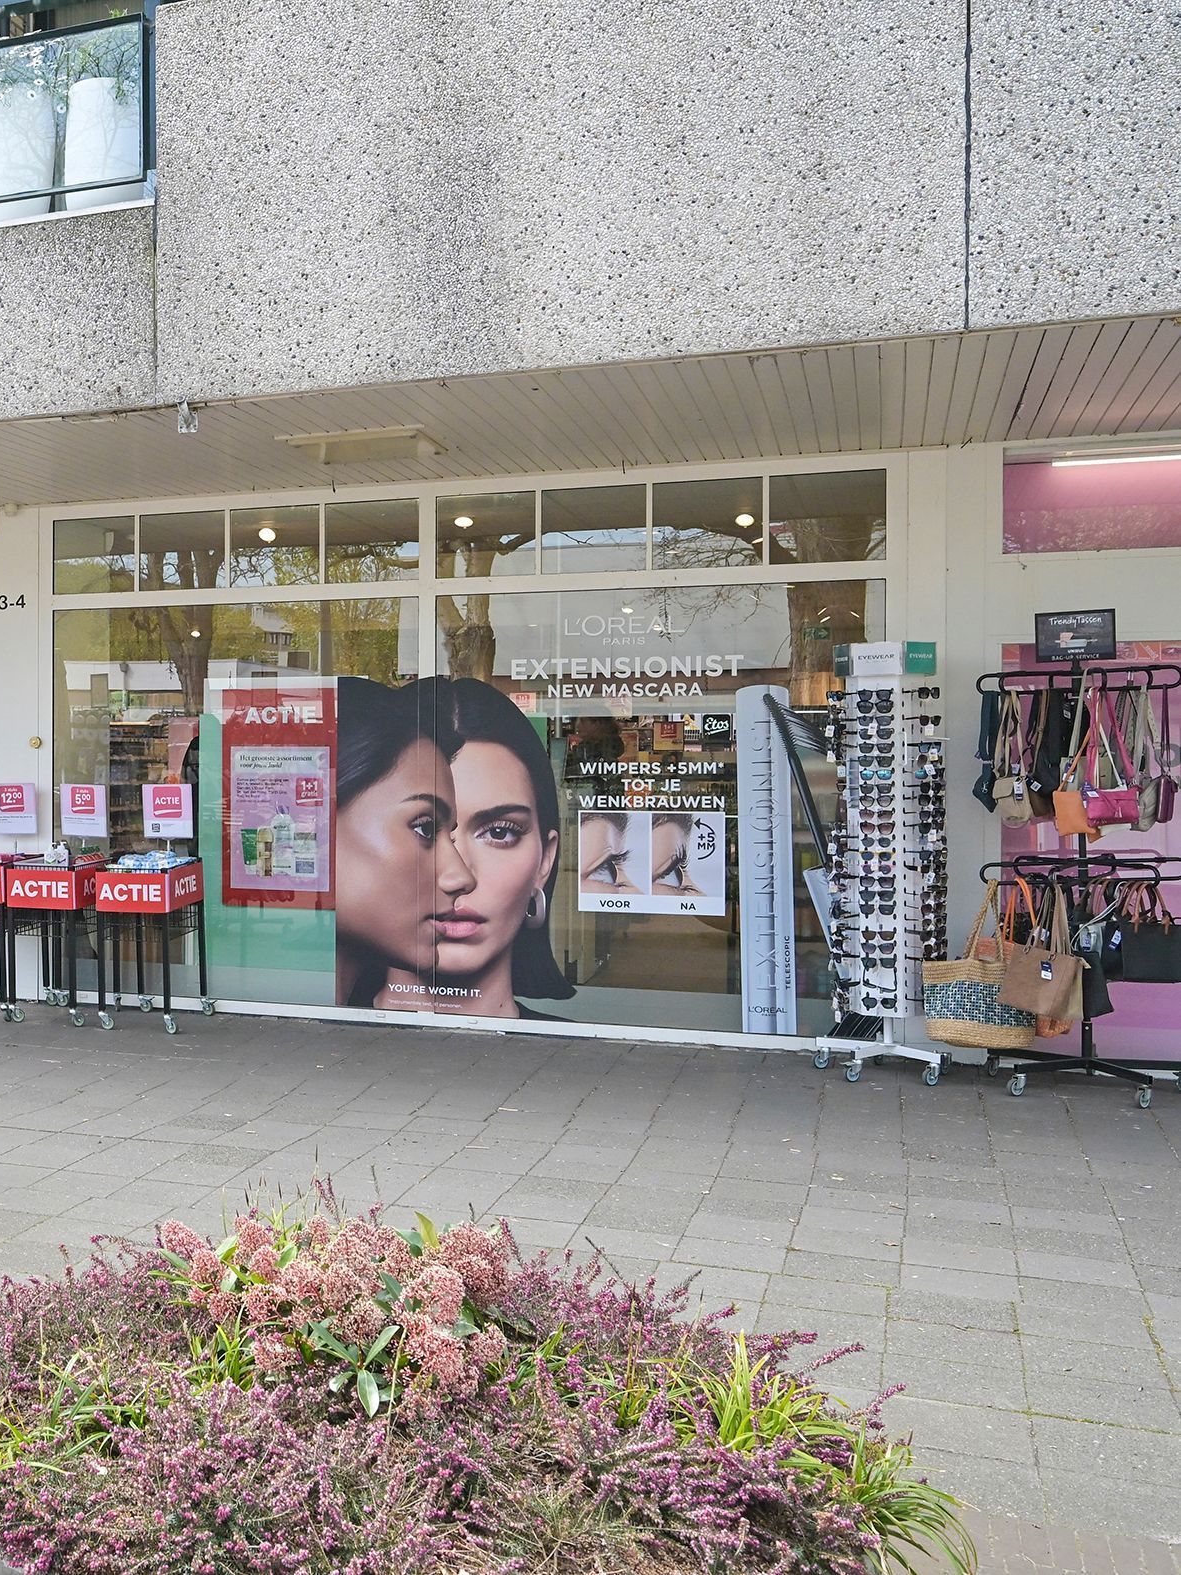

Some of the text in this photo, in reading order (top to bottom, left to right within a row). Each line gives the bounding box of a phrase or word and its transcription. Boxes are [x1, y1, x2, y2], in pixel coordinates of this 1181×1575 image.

[602, 637, 646, 646] PARIS
[510, 654, 745, 680] EXTENSIONIST
[547, 682, 703, 698] NEW MASCARA
[244, 706, 319, 724] ACTIE
[704, 717, 730, 731] Etos
[580, 762, 661, 775] WIMPERS
[300, 780, 318, 790] 1+1
[621, 778, 682, 792] TOT JE
[0, 792, 22, 804] 12.00
[75, 794, 91, 804] 5.00
[155, 797, 180, 805] ACTIE
[578, 795, 725, 809] WENKBRAUWEN
[698, 832, 715, 843] +5
[698, 842, 716, 850] MM
[10, 880, 69, 899] ACTIE
[99, 884, 162, 902] ACTIE
[175, 874, 197, 898] ACTIE
[600, 900, 696, 911] VOOR NA
[388, 984, 482, 998] YOU'RE WORTH IT.
